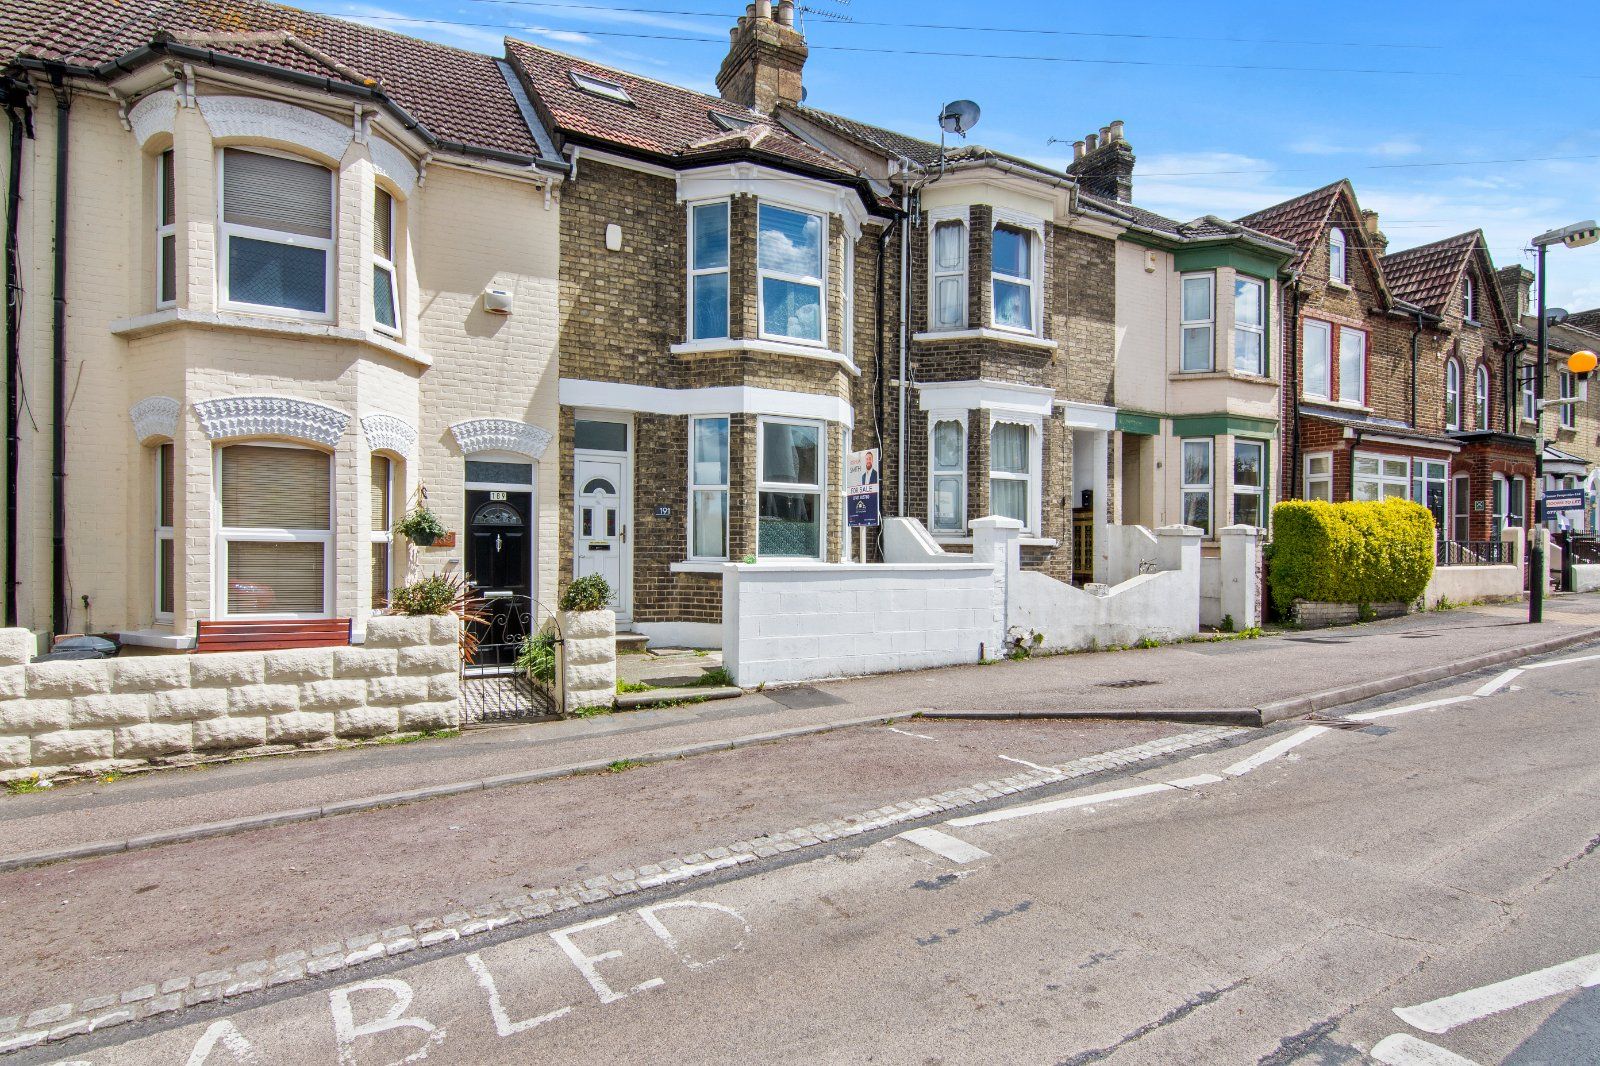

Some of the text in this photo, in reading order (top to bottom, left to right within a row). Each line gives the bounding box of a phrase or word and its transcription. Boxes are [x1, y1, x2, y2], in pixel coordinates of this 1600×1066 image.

[491, 492, 506, 500] 189
[659, 507, 671, 516] 191
[48, 899, 752, 1066] ABLED
